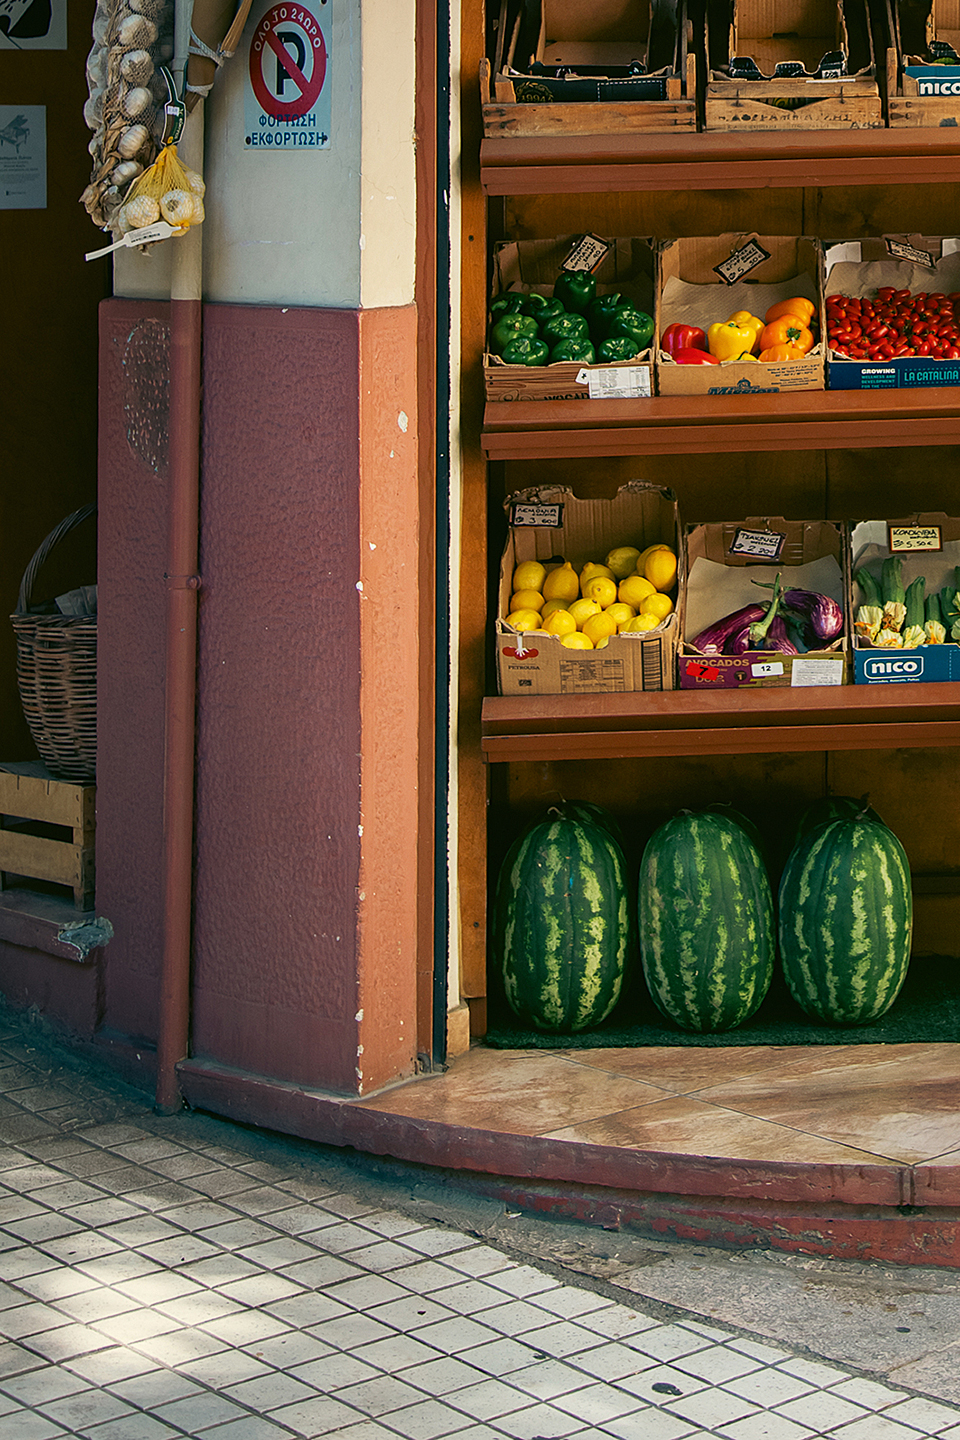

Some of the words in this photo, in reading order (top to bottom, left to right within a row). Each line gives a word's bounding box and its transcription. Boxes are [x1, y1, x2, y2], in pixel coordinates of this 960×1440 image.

[254, 20, 271, 52] ΟΛΟ
[272, 7, 287, 23] ΤΟ
[291, 8, 321, 48] 24ΩΡΟ
[258, 113, 316, 127] ΦΟΡΤΩΣΗ
[251, 131, 325, 146] ΕΚΦΟΡΤΩΣΗ
[904, 371, 915, 381] LA
[916, 370, 959, 381] CATALINA
[699, 666, 709, 676] 7
[871, 661, 918, 674] nico
